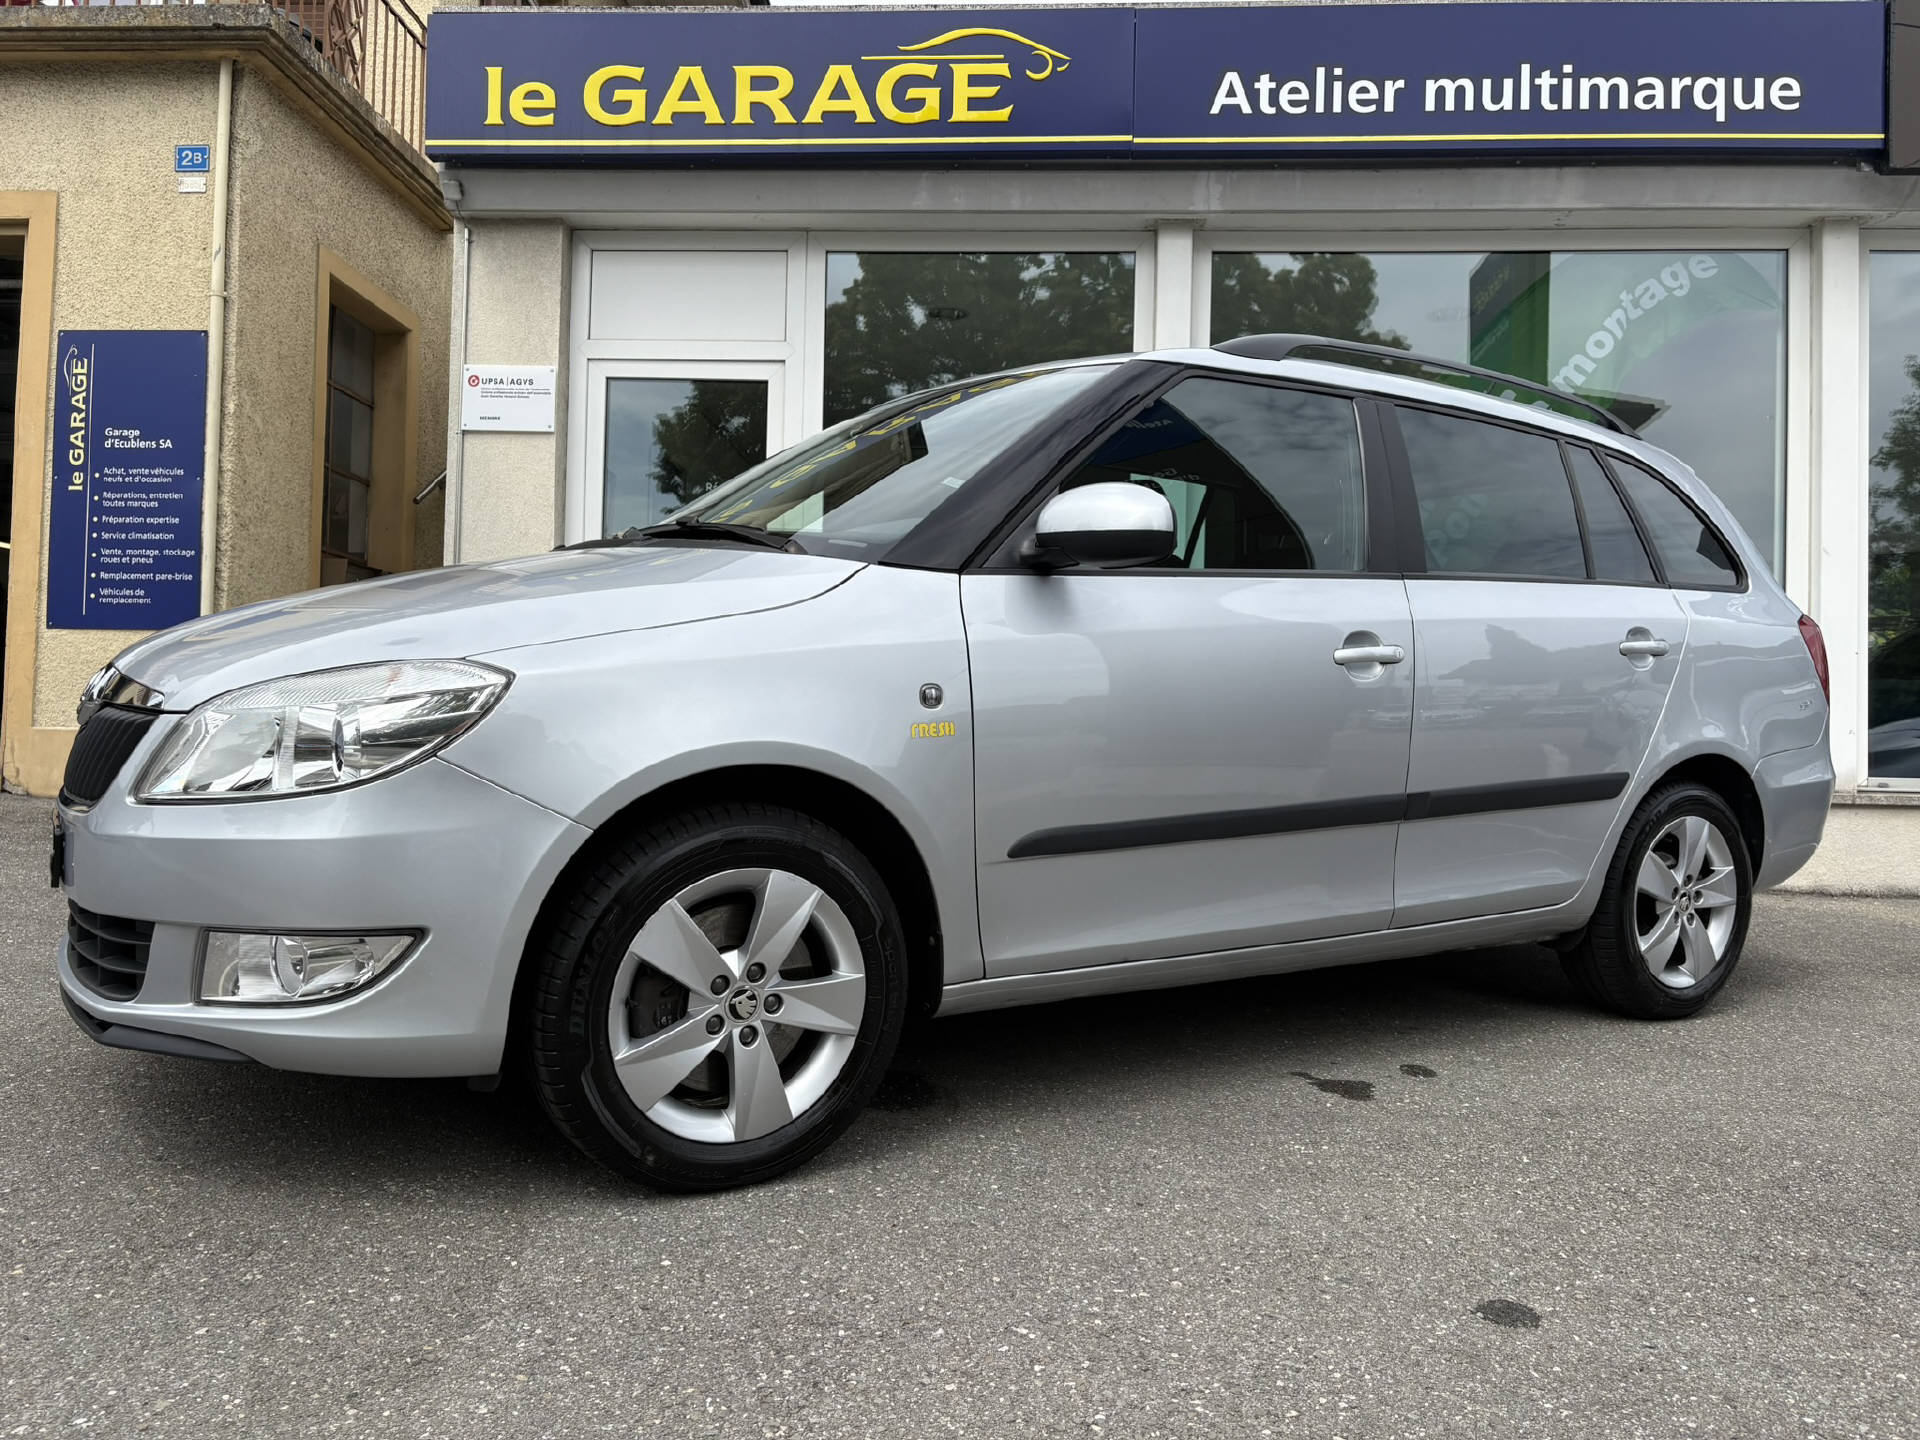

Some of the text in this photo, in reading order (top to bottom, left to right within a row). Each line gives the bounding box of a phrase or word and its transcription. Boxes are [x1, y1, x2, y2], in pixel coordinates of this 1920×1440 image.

[484, 61, 1014, 126] le GARAGE
[1210, 63, 1801, 122] Atelier multimarque
[181, 150, 202, 166] 2B
[1552, 254, 1719, 394] montage
[481, 377, 534, 386] UPSA AGVS
[68, 358, 88, 491] le GARAGE
[105, 428, 140, 437] Garage
[104, 439, 172, 448] d'Ecublens SA
[104, 467, 126, 476] Achat,
[103, 492, 148, 500] Réparations,
[102, 516, 179, 524] Préparation expertise
[102, 532, 174, 540] Service climatisation
[101, 548, 123, 556] Vente,
[163, 548, 195, 556] stockage
[100, 572, 153, 580] Remplacement
[100, 588, 144, 596] Véhicules de
[100, 596, 151, 604] remplacement
